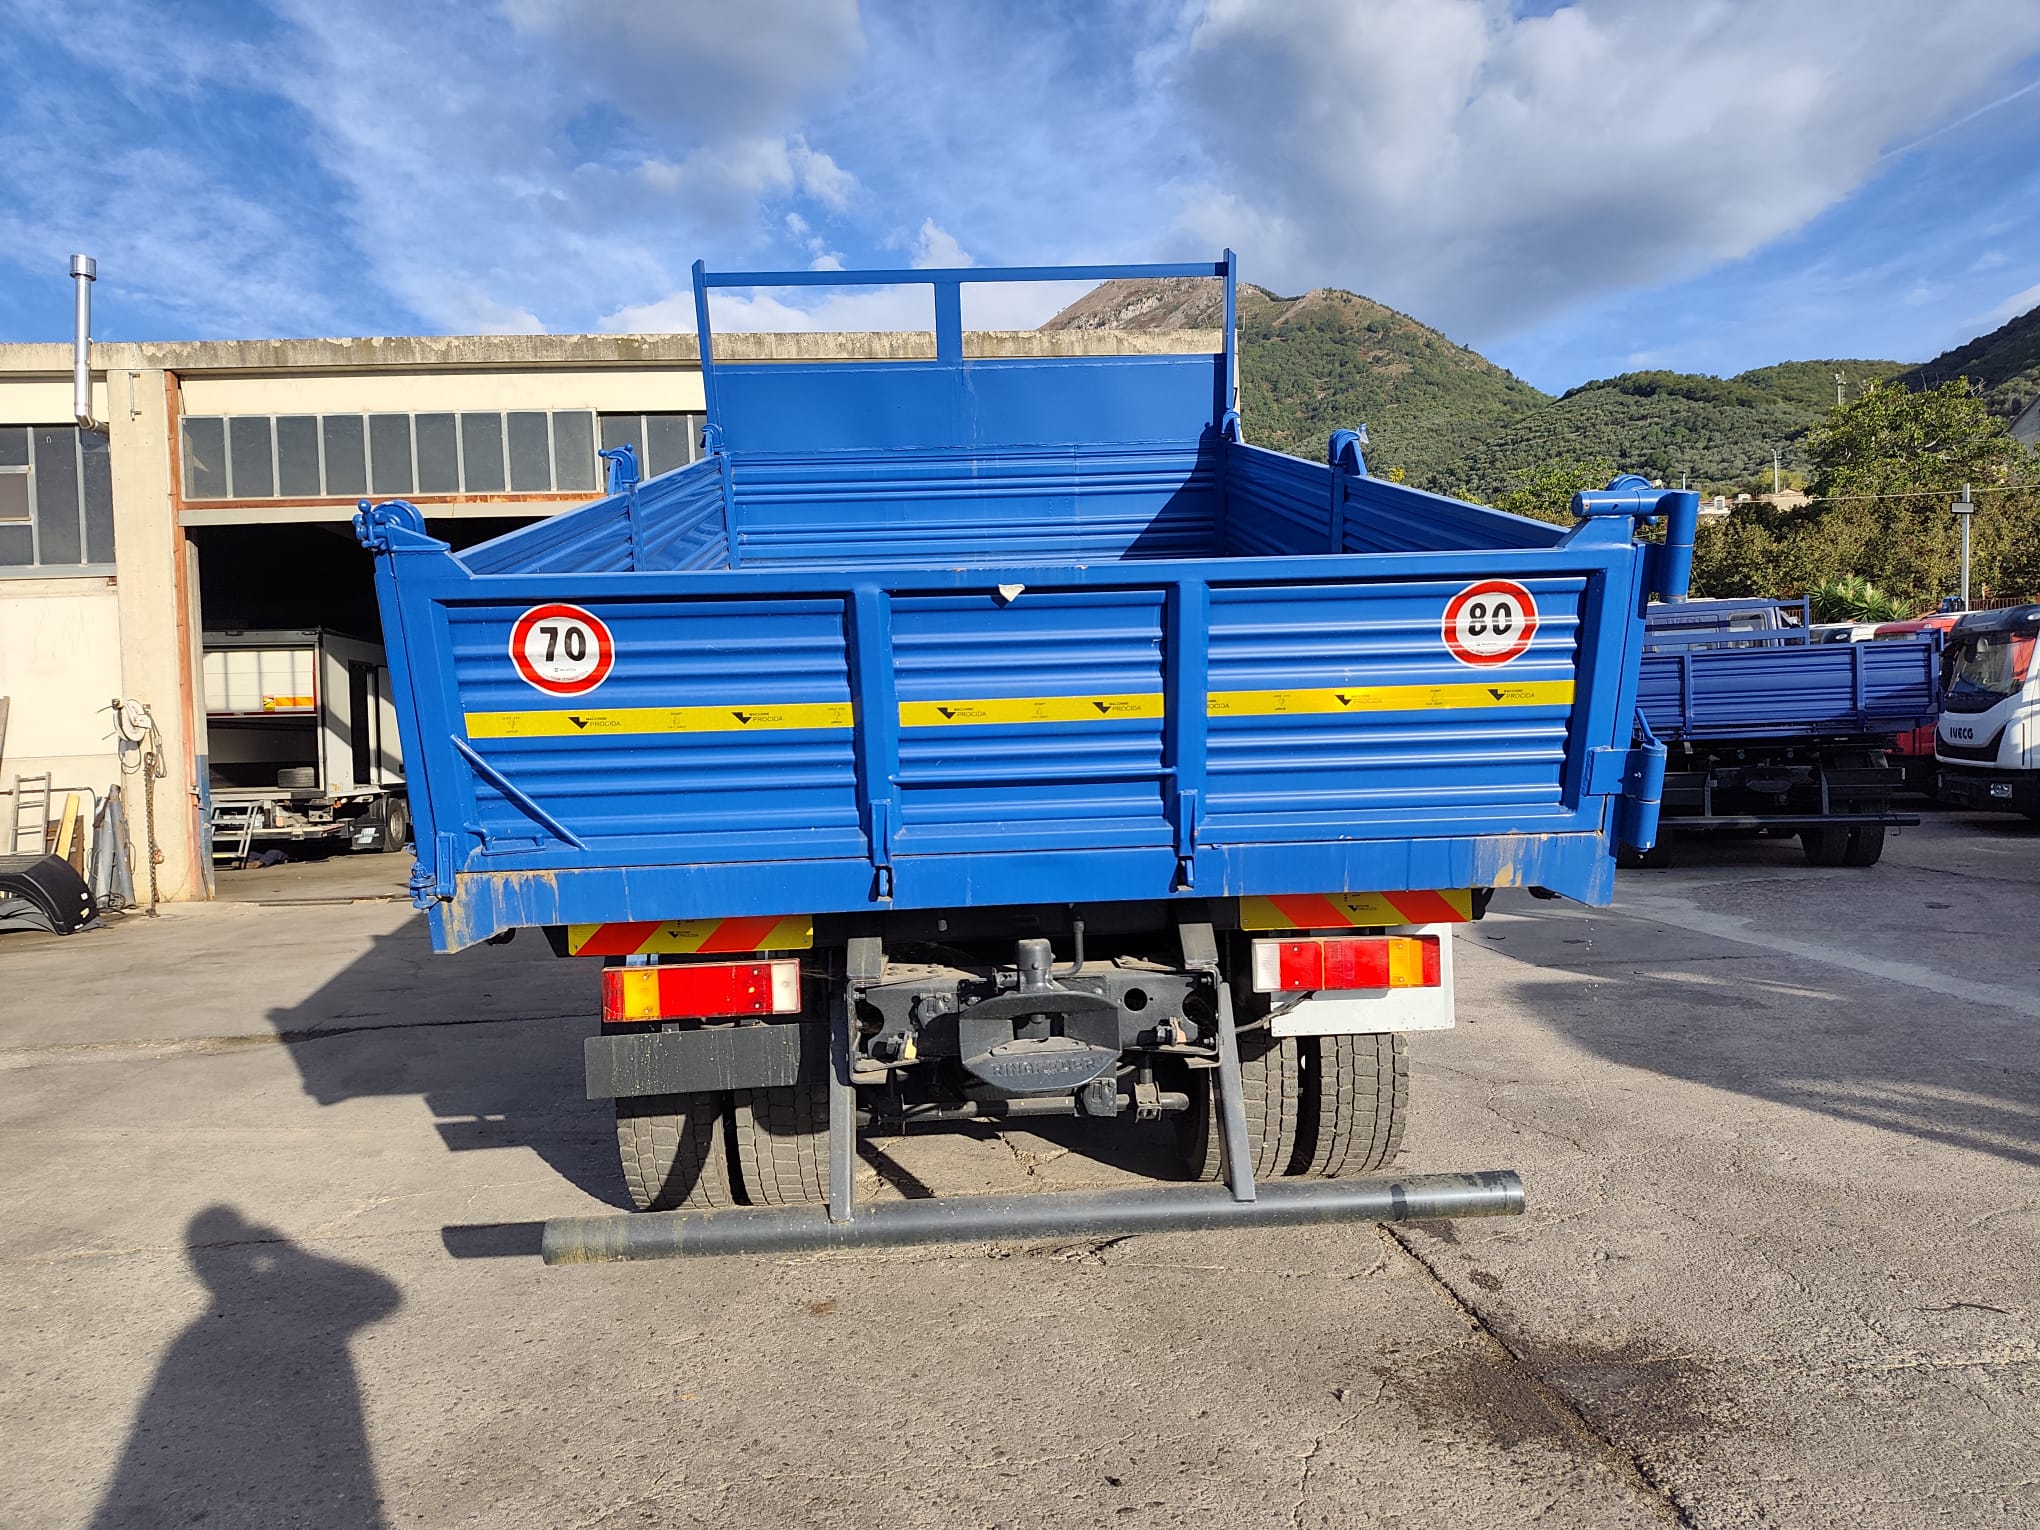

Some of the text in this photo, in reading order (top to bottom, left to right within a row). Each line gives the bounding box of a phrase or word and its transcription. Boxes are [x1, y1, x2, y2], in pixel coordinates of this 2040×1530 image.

[1468, 602, 1513, 636] 80
[540, 626, 586, 662] 70
[1949, 726, 1974, 740] IVECO
